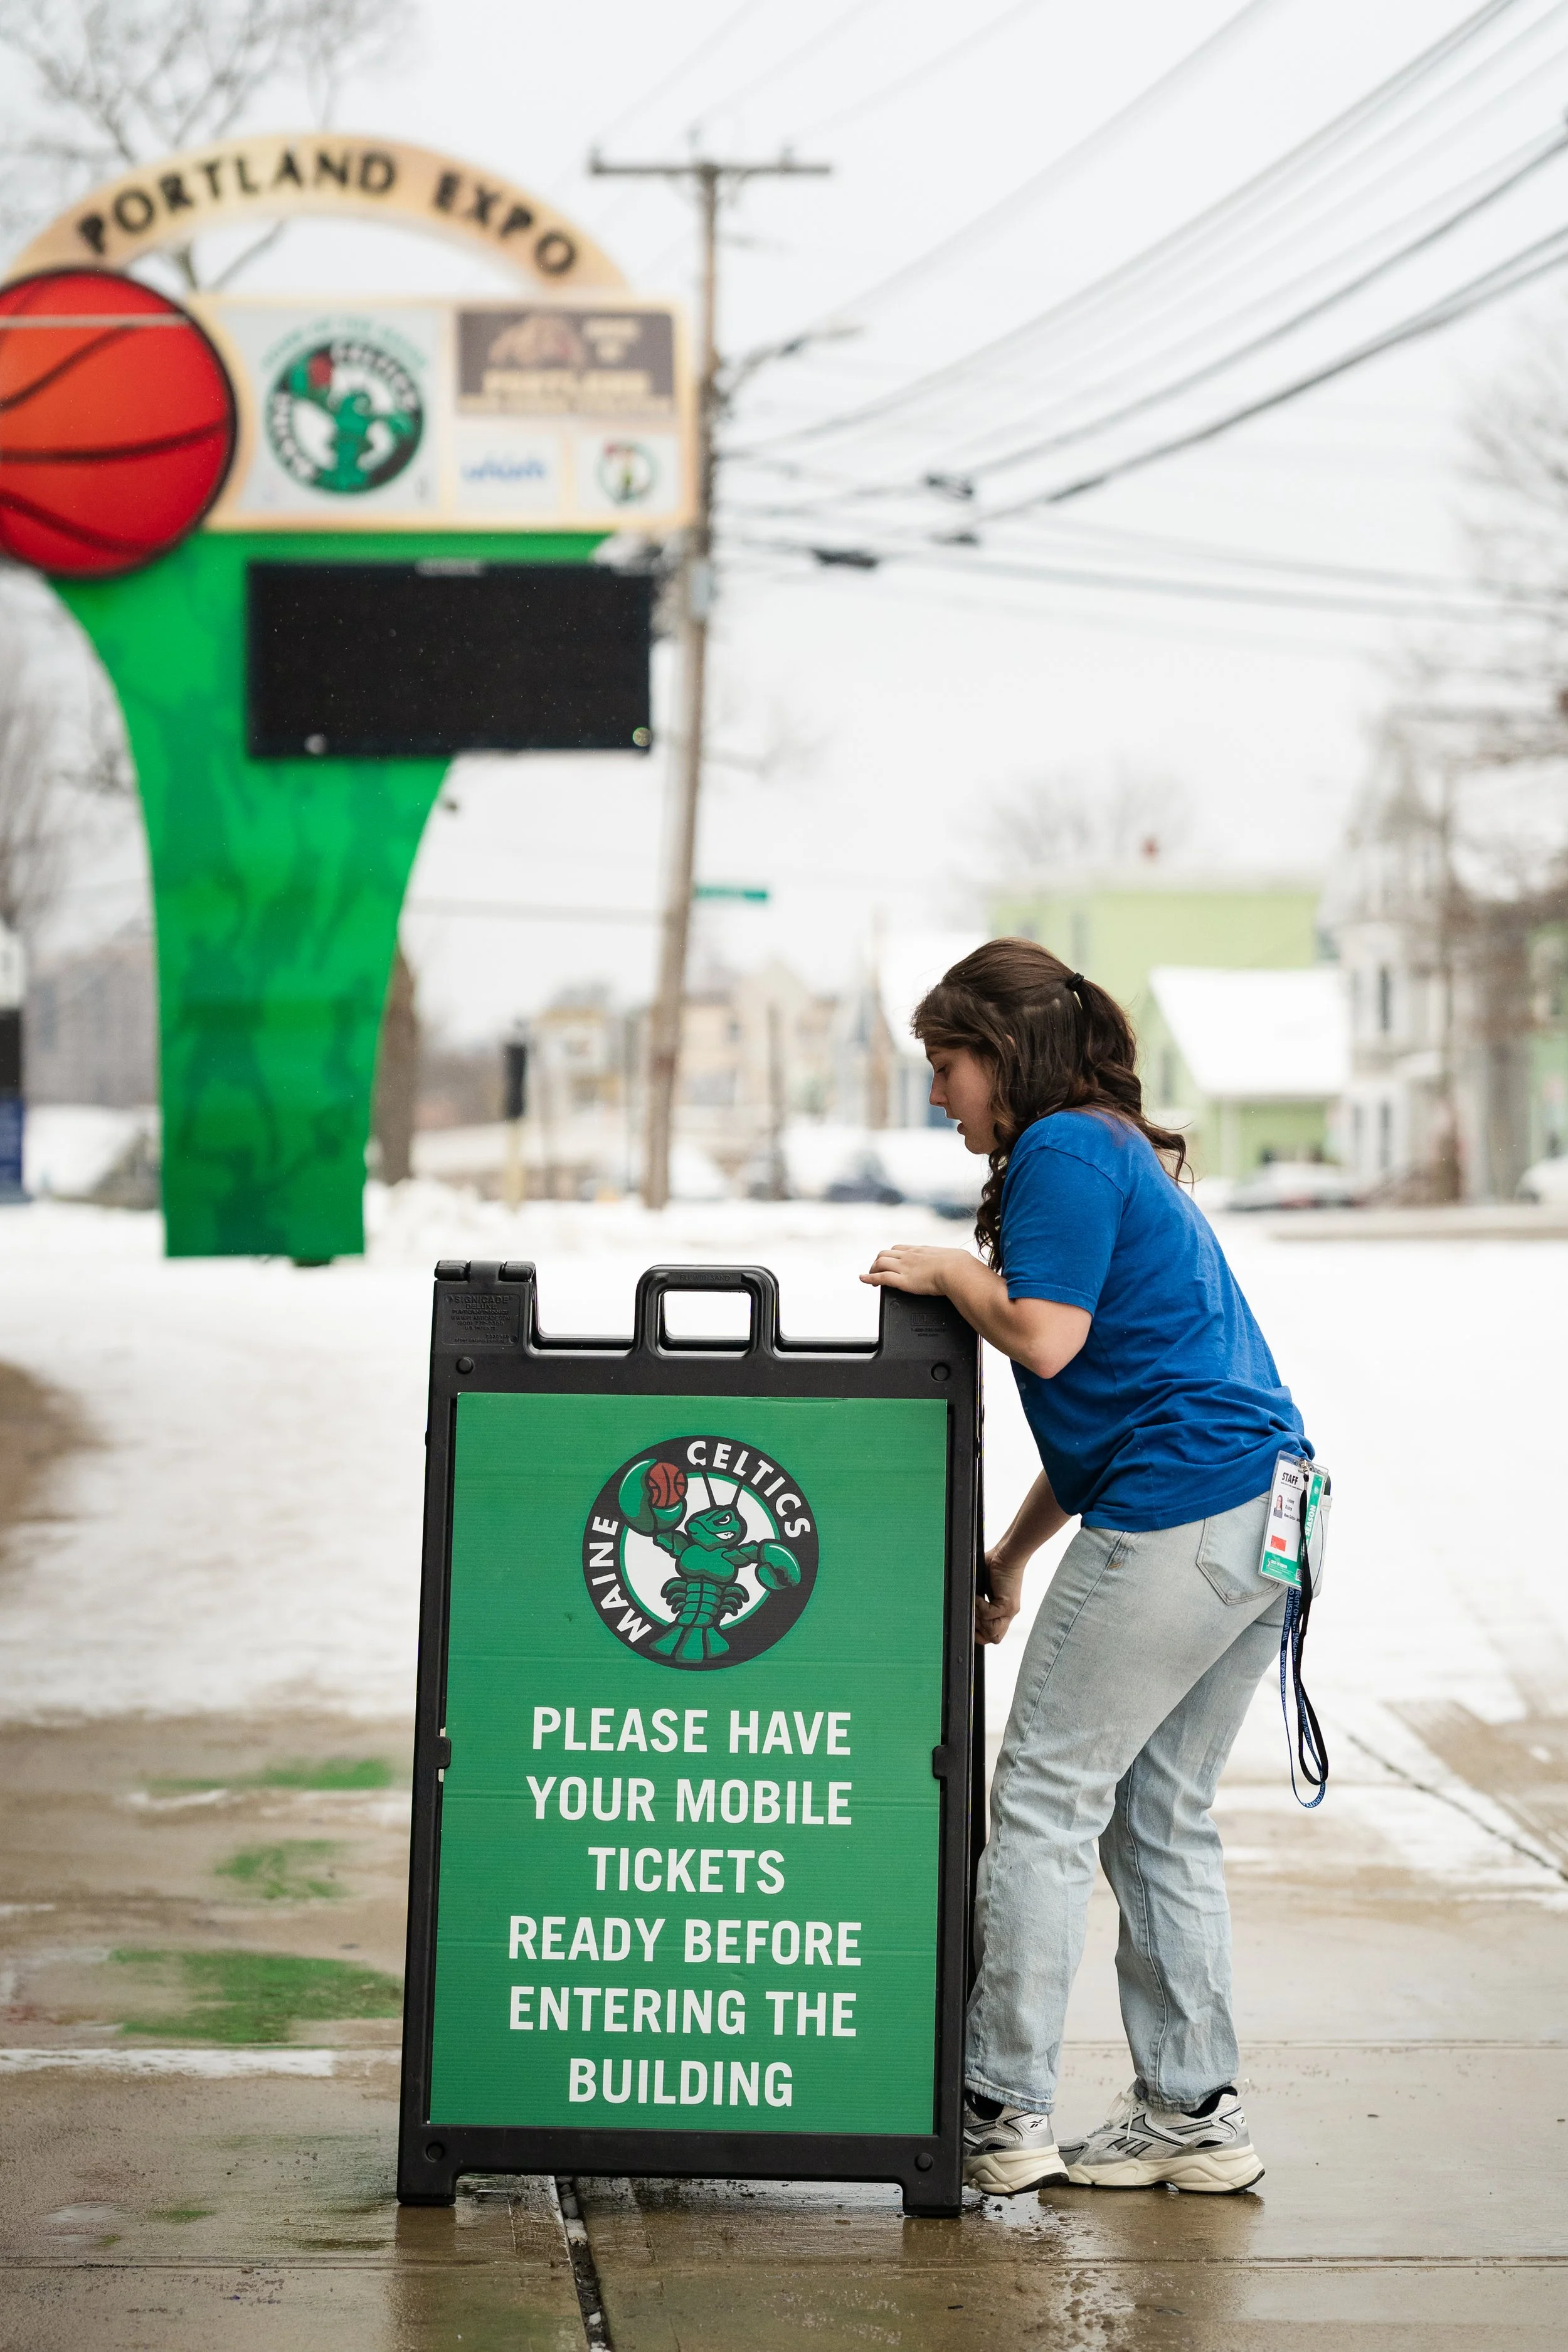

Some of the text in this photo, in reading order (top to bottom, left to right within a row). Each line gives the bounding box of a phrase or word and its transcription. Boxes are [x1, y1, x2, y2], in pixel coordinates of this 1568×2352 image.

[76, 149, 580, 277] PORTLAND EXPO
[454, 1295, 509, 1304] SIGNICADE
[686, 1441, 811, 1540] CELTICS
[1282, 1472, 1299, 1485] STAFF
[1306, 1504, 1316, 1538] SEASON
[589, 1515, 652, 1643] MAINE
[1285, 1596, 1294, 1633] UNIVERSITY
[533, 1707, 851, 1756] PLEASE HAVE
[526, 1776, 852, 1825] YOUR MOBILE
[588, 1846, 785, 1894] TICKETS
[509, 1915, 862, 1966] READY BEFORE
[509, 1986, 857, 2037] ENTERING THE
[569, 2058, 793, 2107] BUILDING
